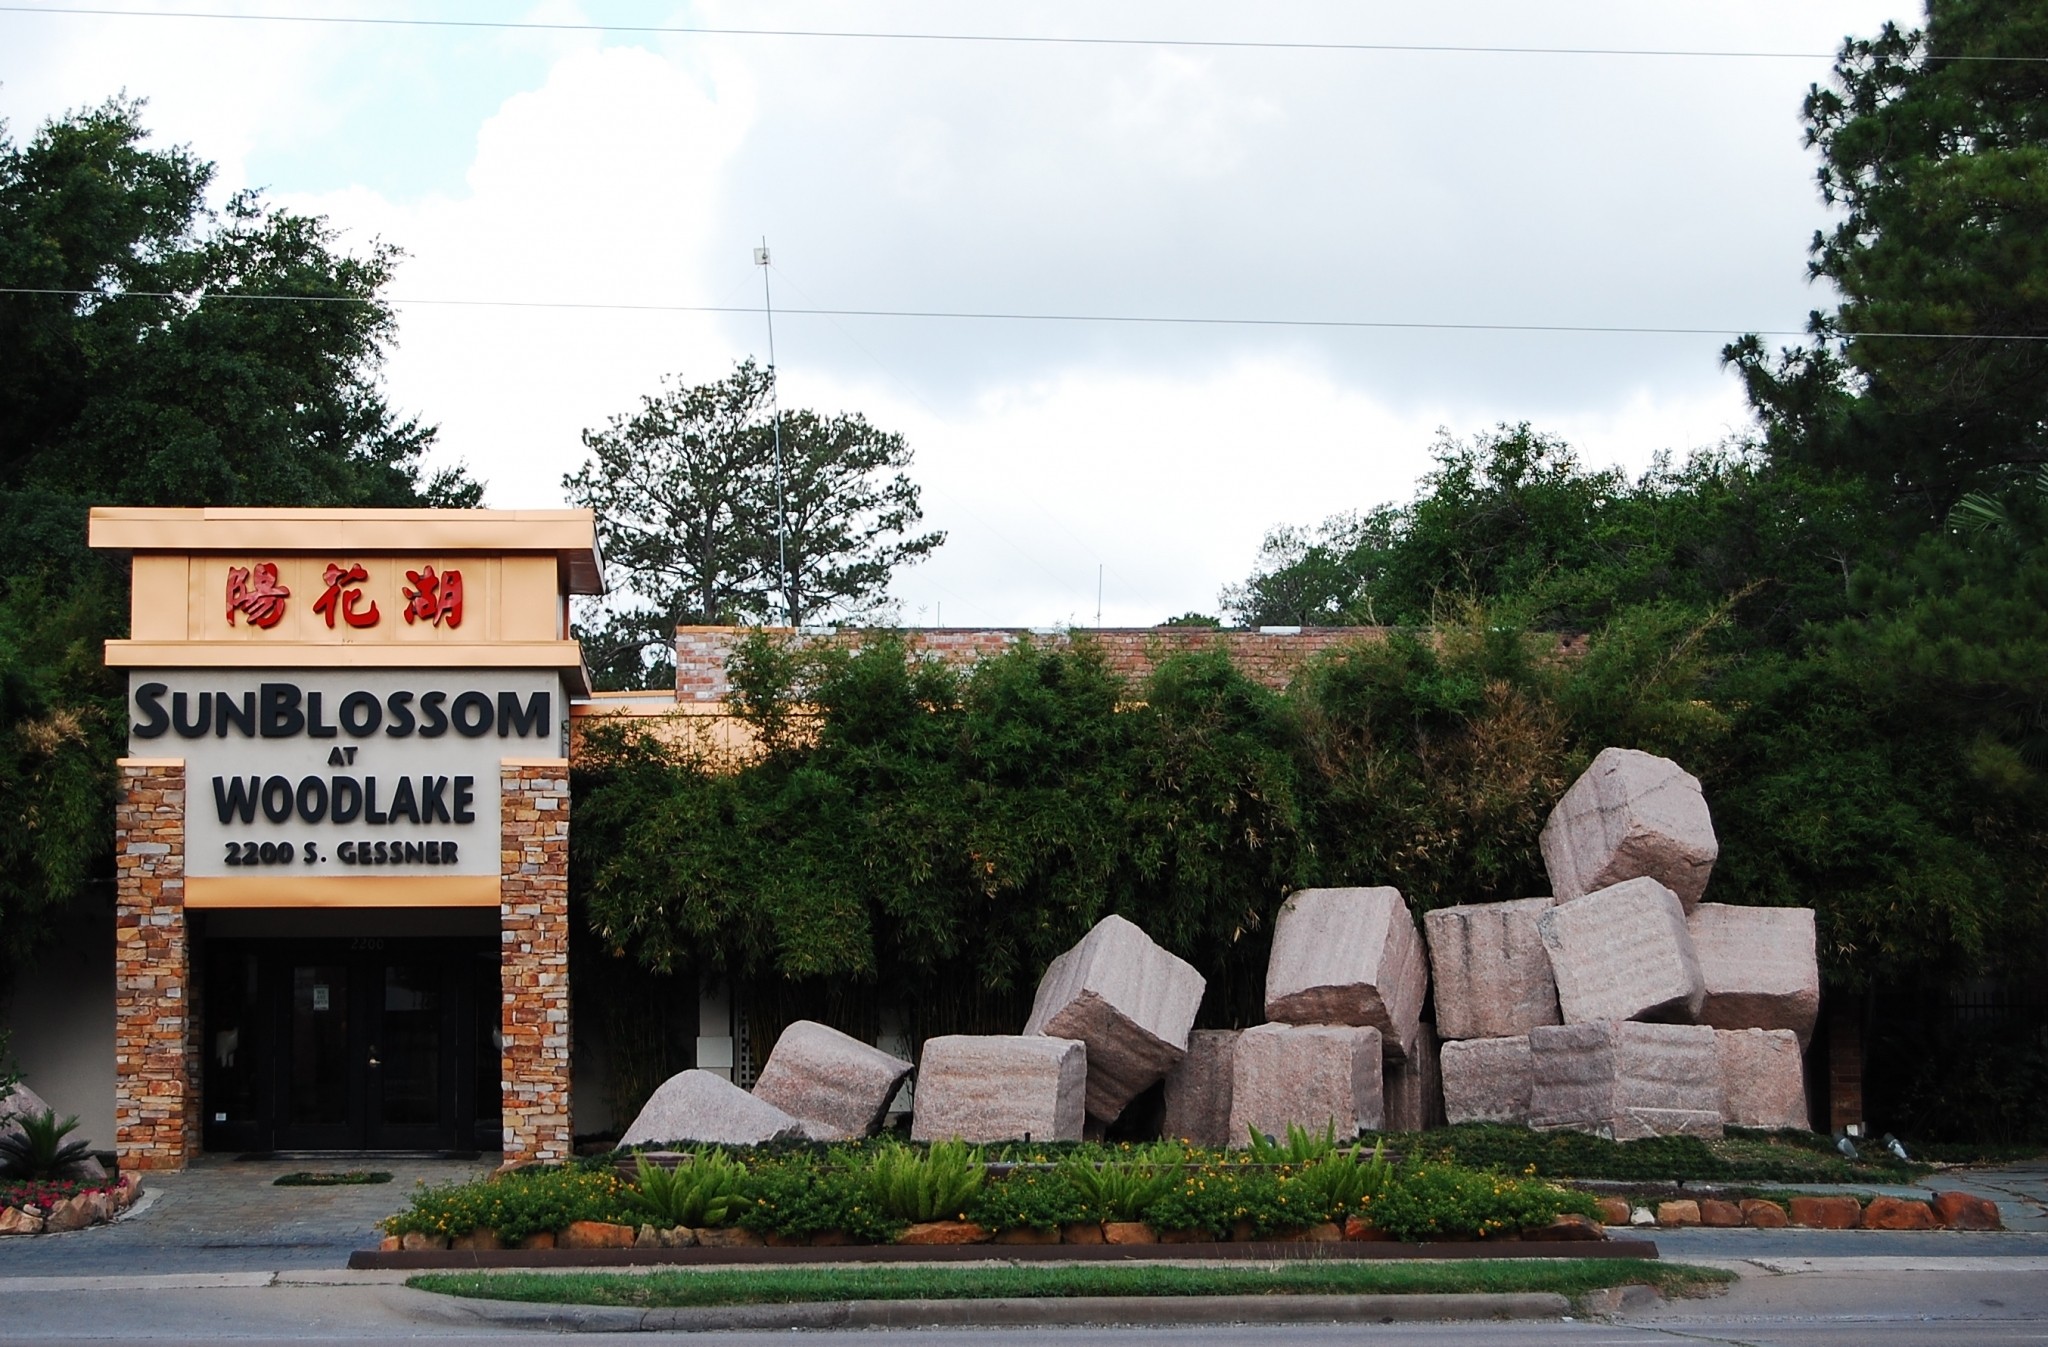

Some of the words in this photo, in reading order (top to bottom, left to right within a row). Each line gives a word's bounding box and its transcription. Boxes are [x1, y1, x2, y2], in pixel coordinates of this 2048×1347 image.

[132, 683, 551, 739] SUNBLOSSOM
[327, 746, 359, 766] AT
[212, 775, 475, 825] WOODLAKE
[224, 841, 294, 865] 2200
[303, 842, 327, 864] S.
[337, 841, 459, 865] GESSNER
[351, 937, 385, 950] 2200
